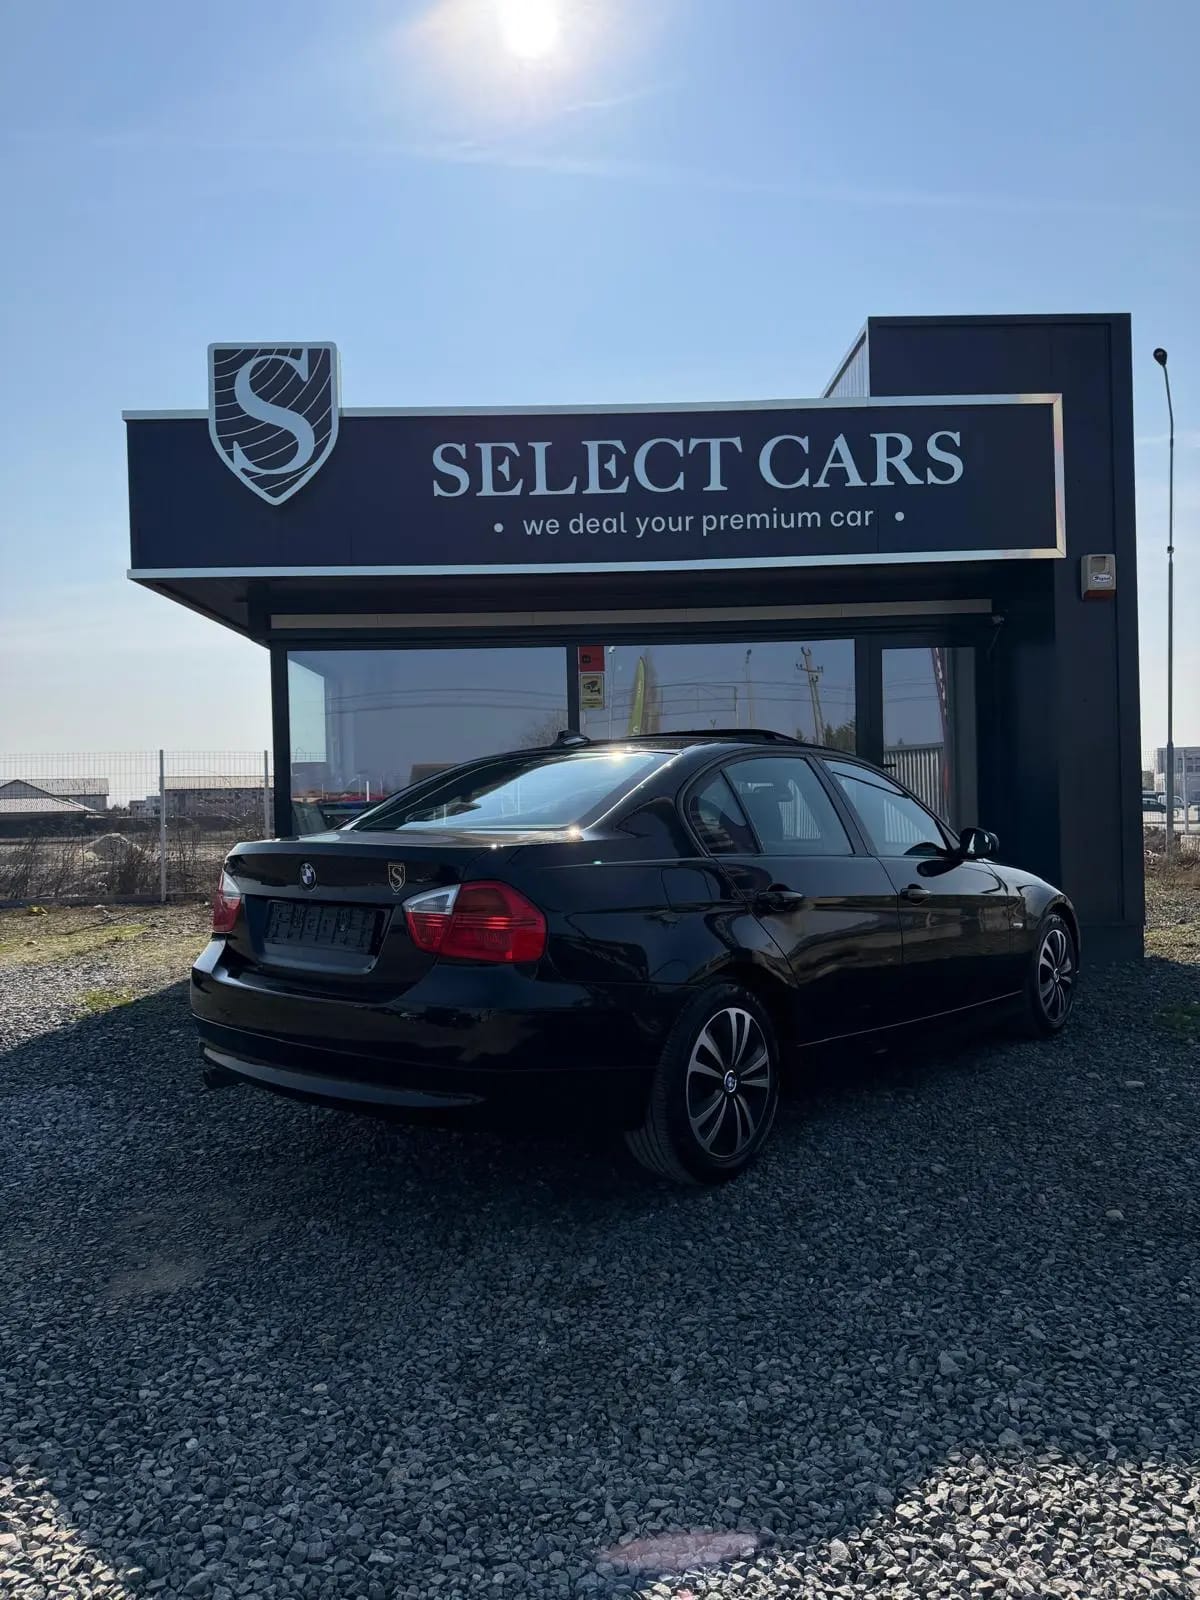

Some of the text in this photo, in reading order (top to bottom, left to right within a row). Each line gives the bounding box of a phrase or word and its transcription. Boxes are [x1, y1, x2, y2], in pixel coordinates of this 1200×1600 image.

[234, 349, 315, 475] S
[432, 430, 964, 497] SELECT CARS
[522, 507, 874, 539] we deal your premium car
